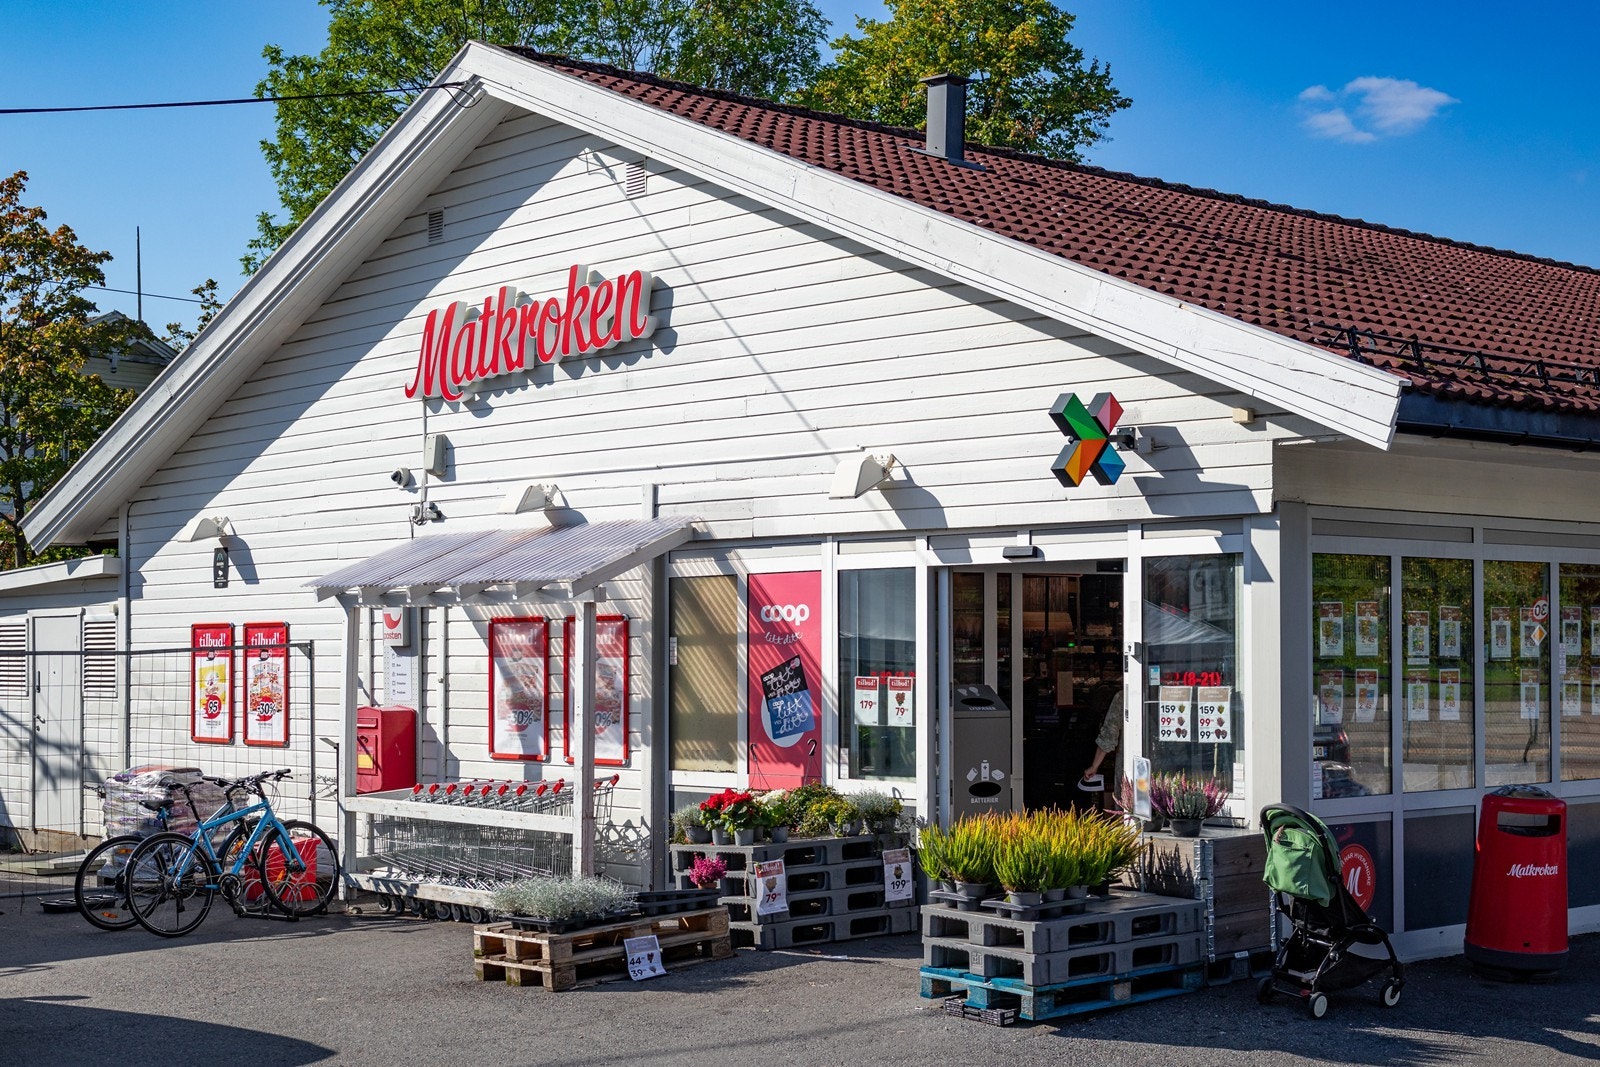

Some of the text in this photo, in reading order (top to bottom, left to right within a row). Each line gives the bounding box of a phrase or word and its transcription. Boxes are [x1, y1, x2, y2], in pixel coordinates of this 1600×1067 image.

[404, 264, 648, 402] Matkroken
[760, 604, 810, 626] coop
[199, 633, 226, 647] tilbud!
[251, 632, 280, 646] tilbud!
[1183, 671, 1222, 687] (8-21)
[209, 701, 218, 713] 95
[258, 703, 277, 715] -30%
[860, 700, 874, 709] 179
[1161, 705, 1176, 713] 159
[895, 707, 905, 716] 79
[1200, 706, 1215, 714] 159
[507, 710, 534, 725] -30%
[1161, 717, 1172, 726] 99
[1200, 718, 1211, 727] 99
[1161, 730, 1172, 738] 99
[1200, 731, 1211, 739] 99
[1343, 852, 1354, 862] HAR
[1354, 852, 1371, 886] HVERANDRE
[1506, 864, 1559, 878] Matkroken
[891, 880, 907, 890] 199
[1346, 866, 1363, 897] M
[766, 893, 777, 903] 79
[630, 957, 641, 966] 44
[630, 969, 643, 977] 39
